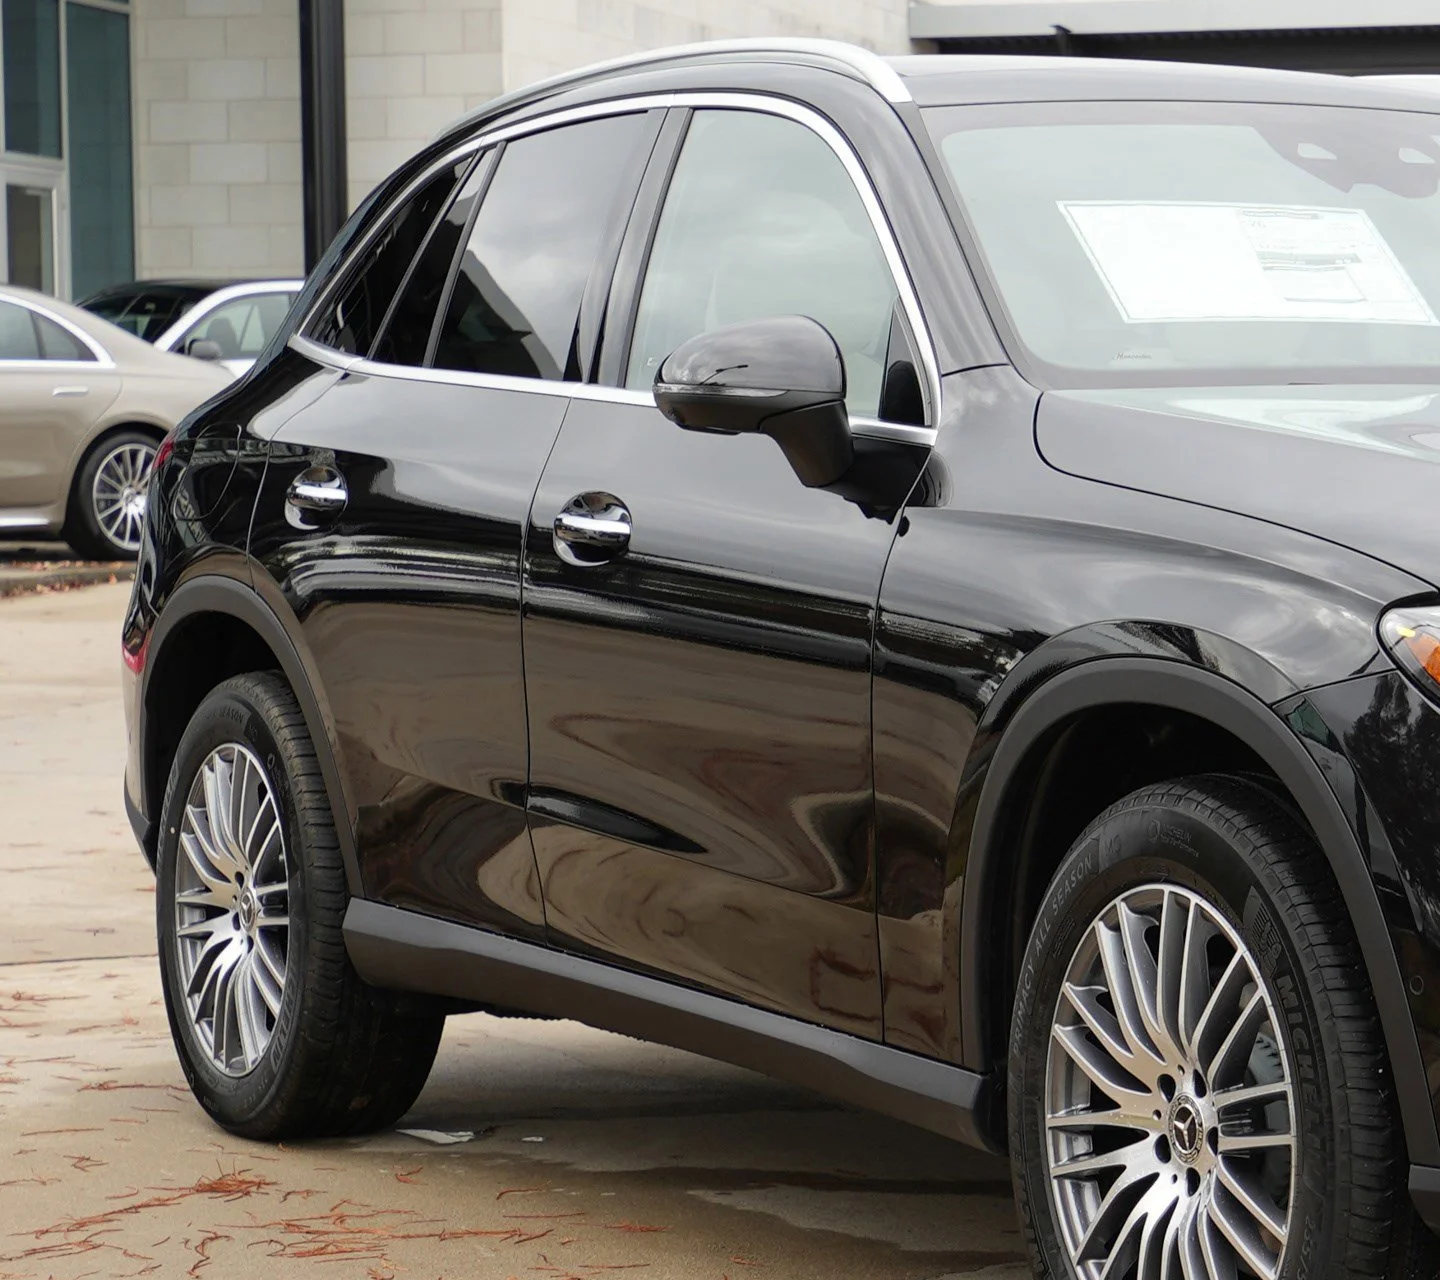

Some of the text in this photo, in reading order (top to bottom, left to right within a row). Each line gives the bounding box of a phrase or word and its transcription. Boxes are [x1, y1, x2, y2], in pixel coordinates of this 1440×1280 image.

[1013, 962, 1034, 1057] PRIMACY
[1035, 922, 1051, 956] ALL
[1052, 854, 1093, 916] SEASON
